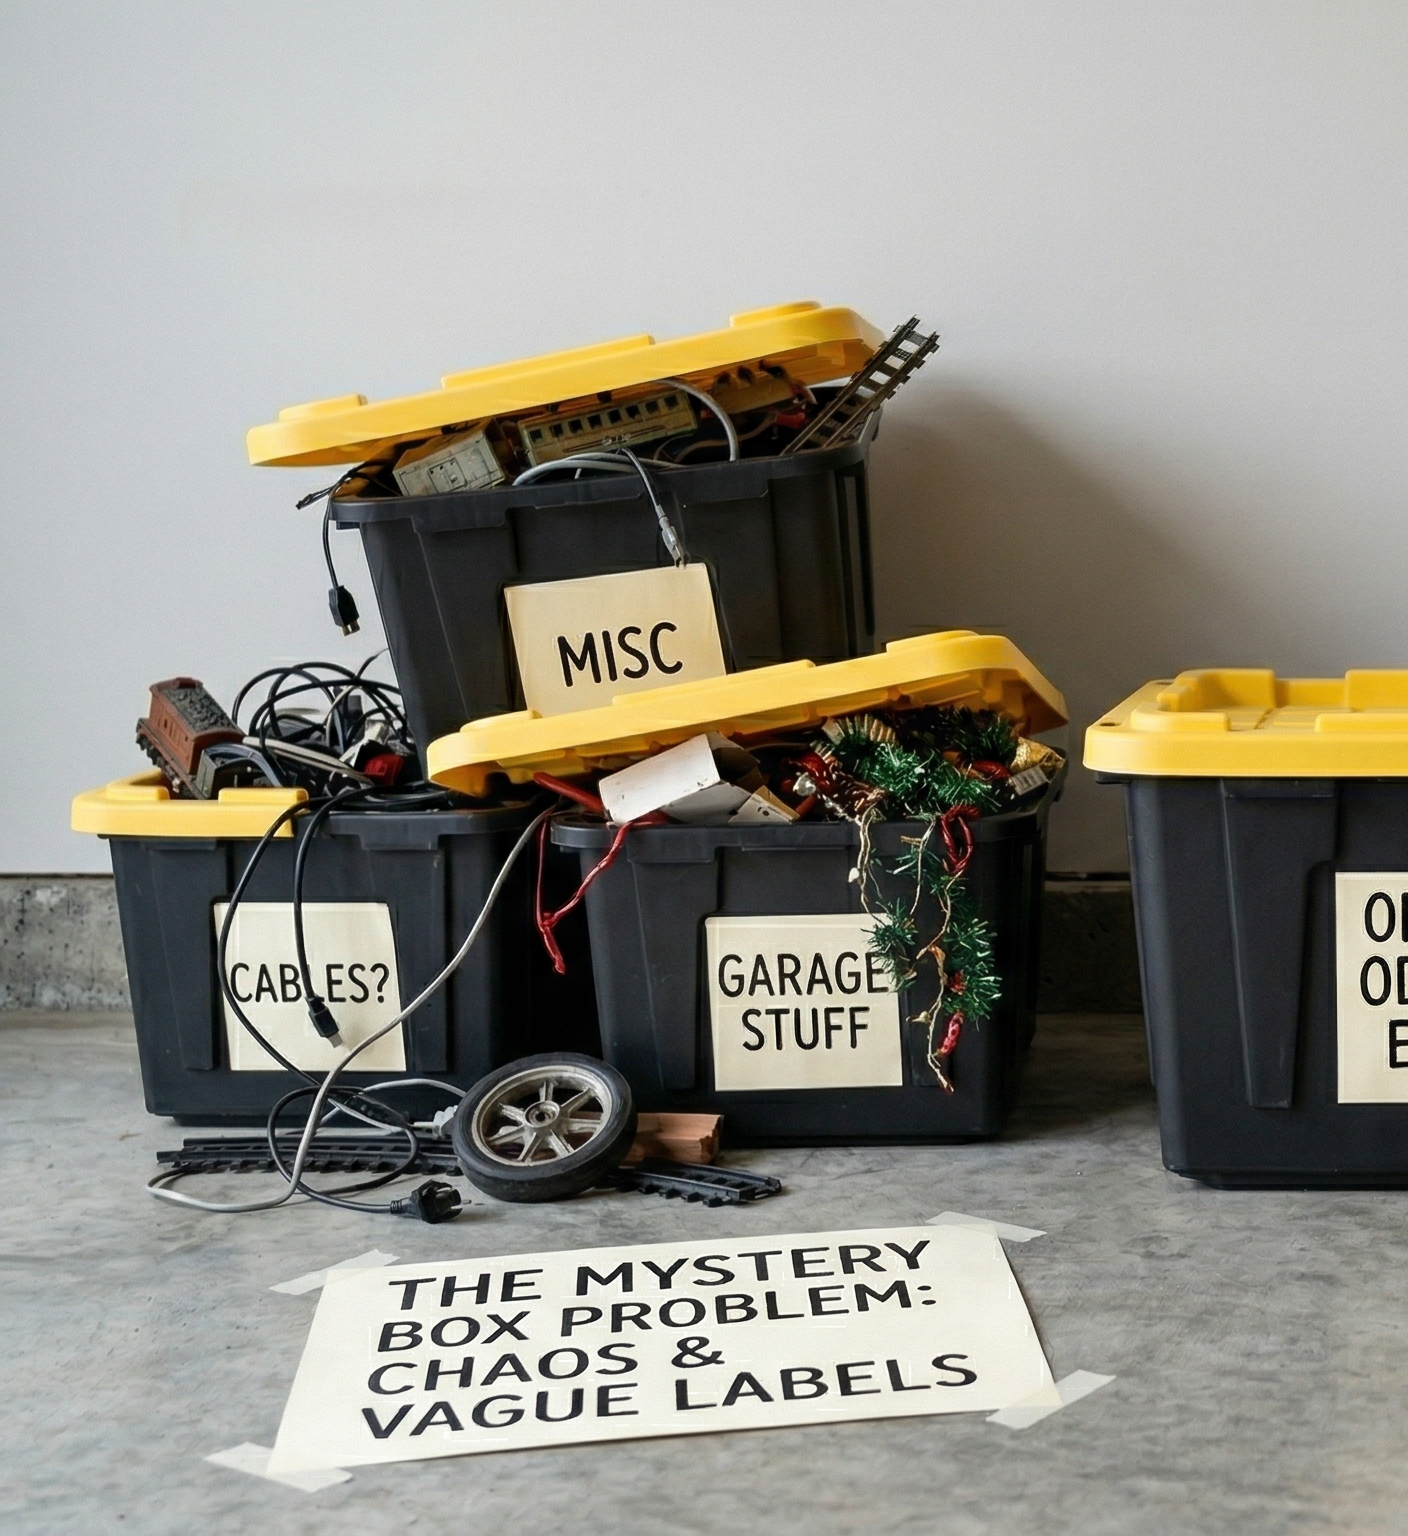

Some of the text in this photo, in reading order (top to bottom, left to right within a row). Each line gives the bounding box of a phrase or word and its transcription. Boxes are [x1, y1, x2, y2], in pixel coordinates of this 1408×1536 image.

[557, 621, 683, 688] MISC
[717, 951, 890, 999] GARAGE
[741, 1006, 871, 1052] STUFF
[387, 1239, 932, 1312] THE MYSTERY
[376, 1279, 938, 1353] BOX PROBLEM:
[360, 1352, 979, 1440] VAGUE LABELS
[366, 1335, 726, 1396] CHAOS &
